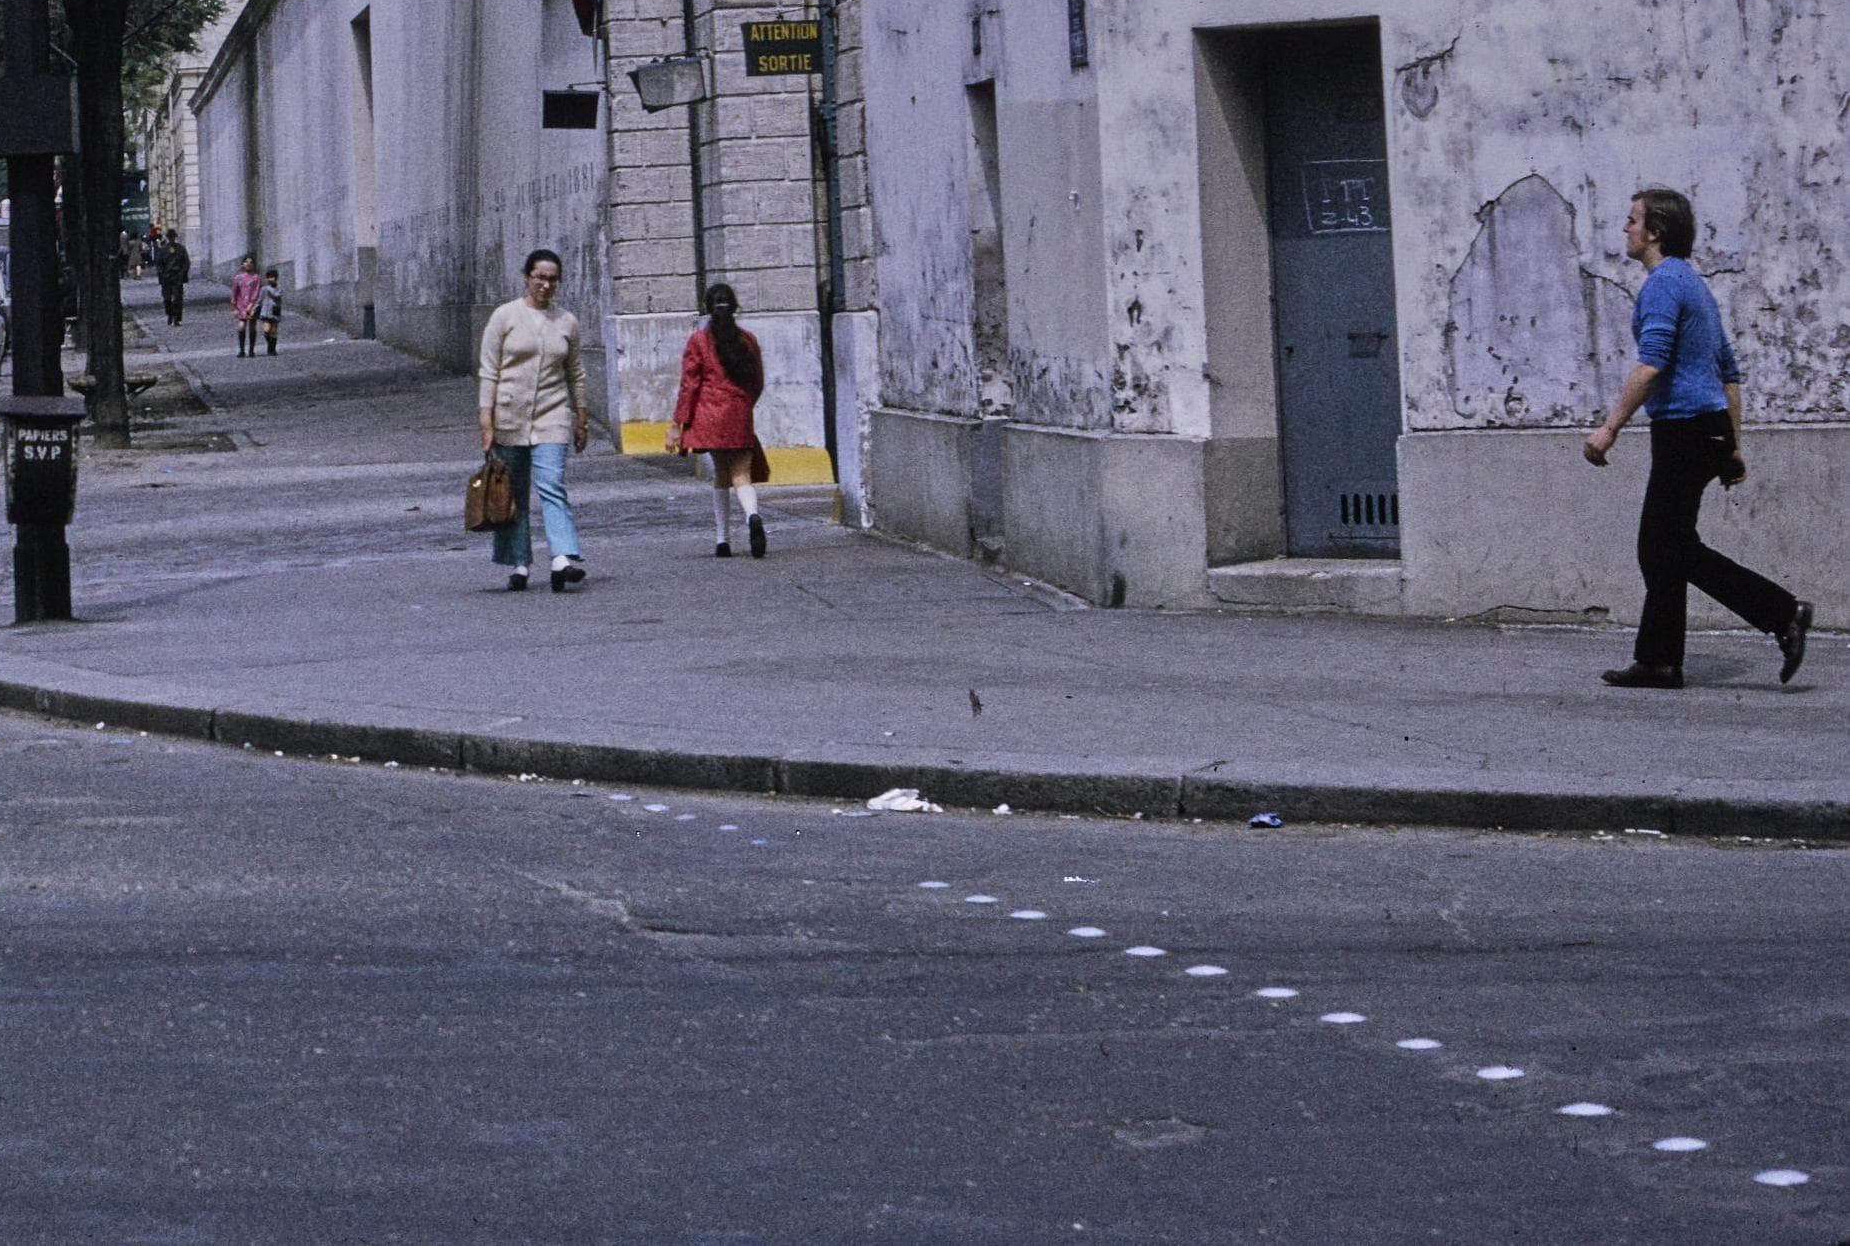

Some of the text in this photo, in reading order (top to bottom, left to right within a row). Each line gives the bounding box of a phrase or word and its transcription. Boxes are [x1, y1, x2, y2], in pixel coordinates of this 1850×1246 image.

[750, 22, 819, 42] ATTENTION
[758, 54, 812, 73] SORTIE
[17, 428, 69, 442] PAPIERS
